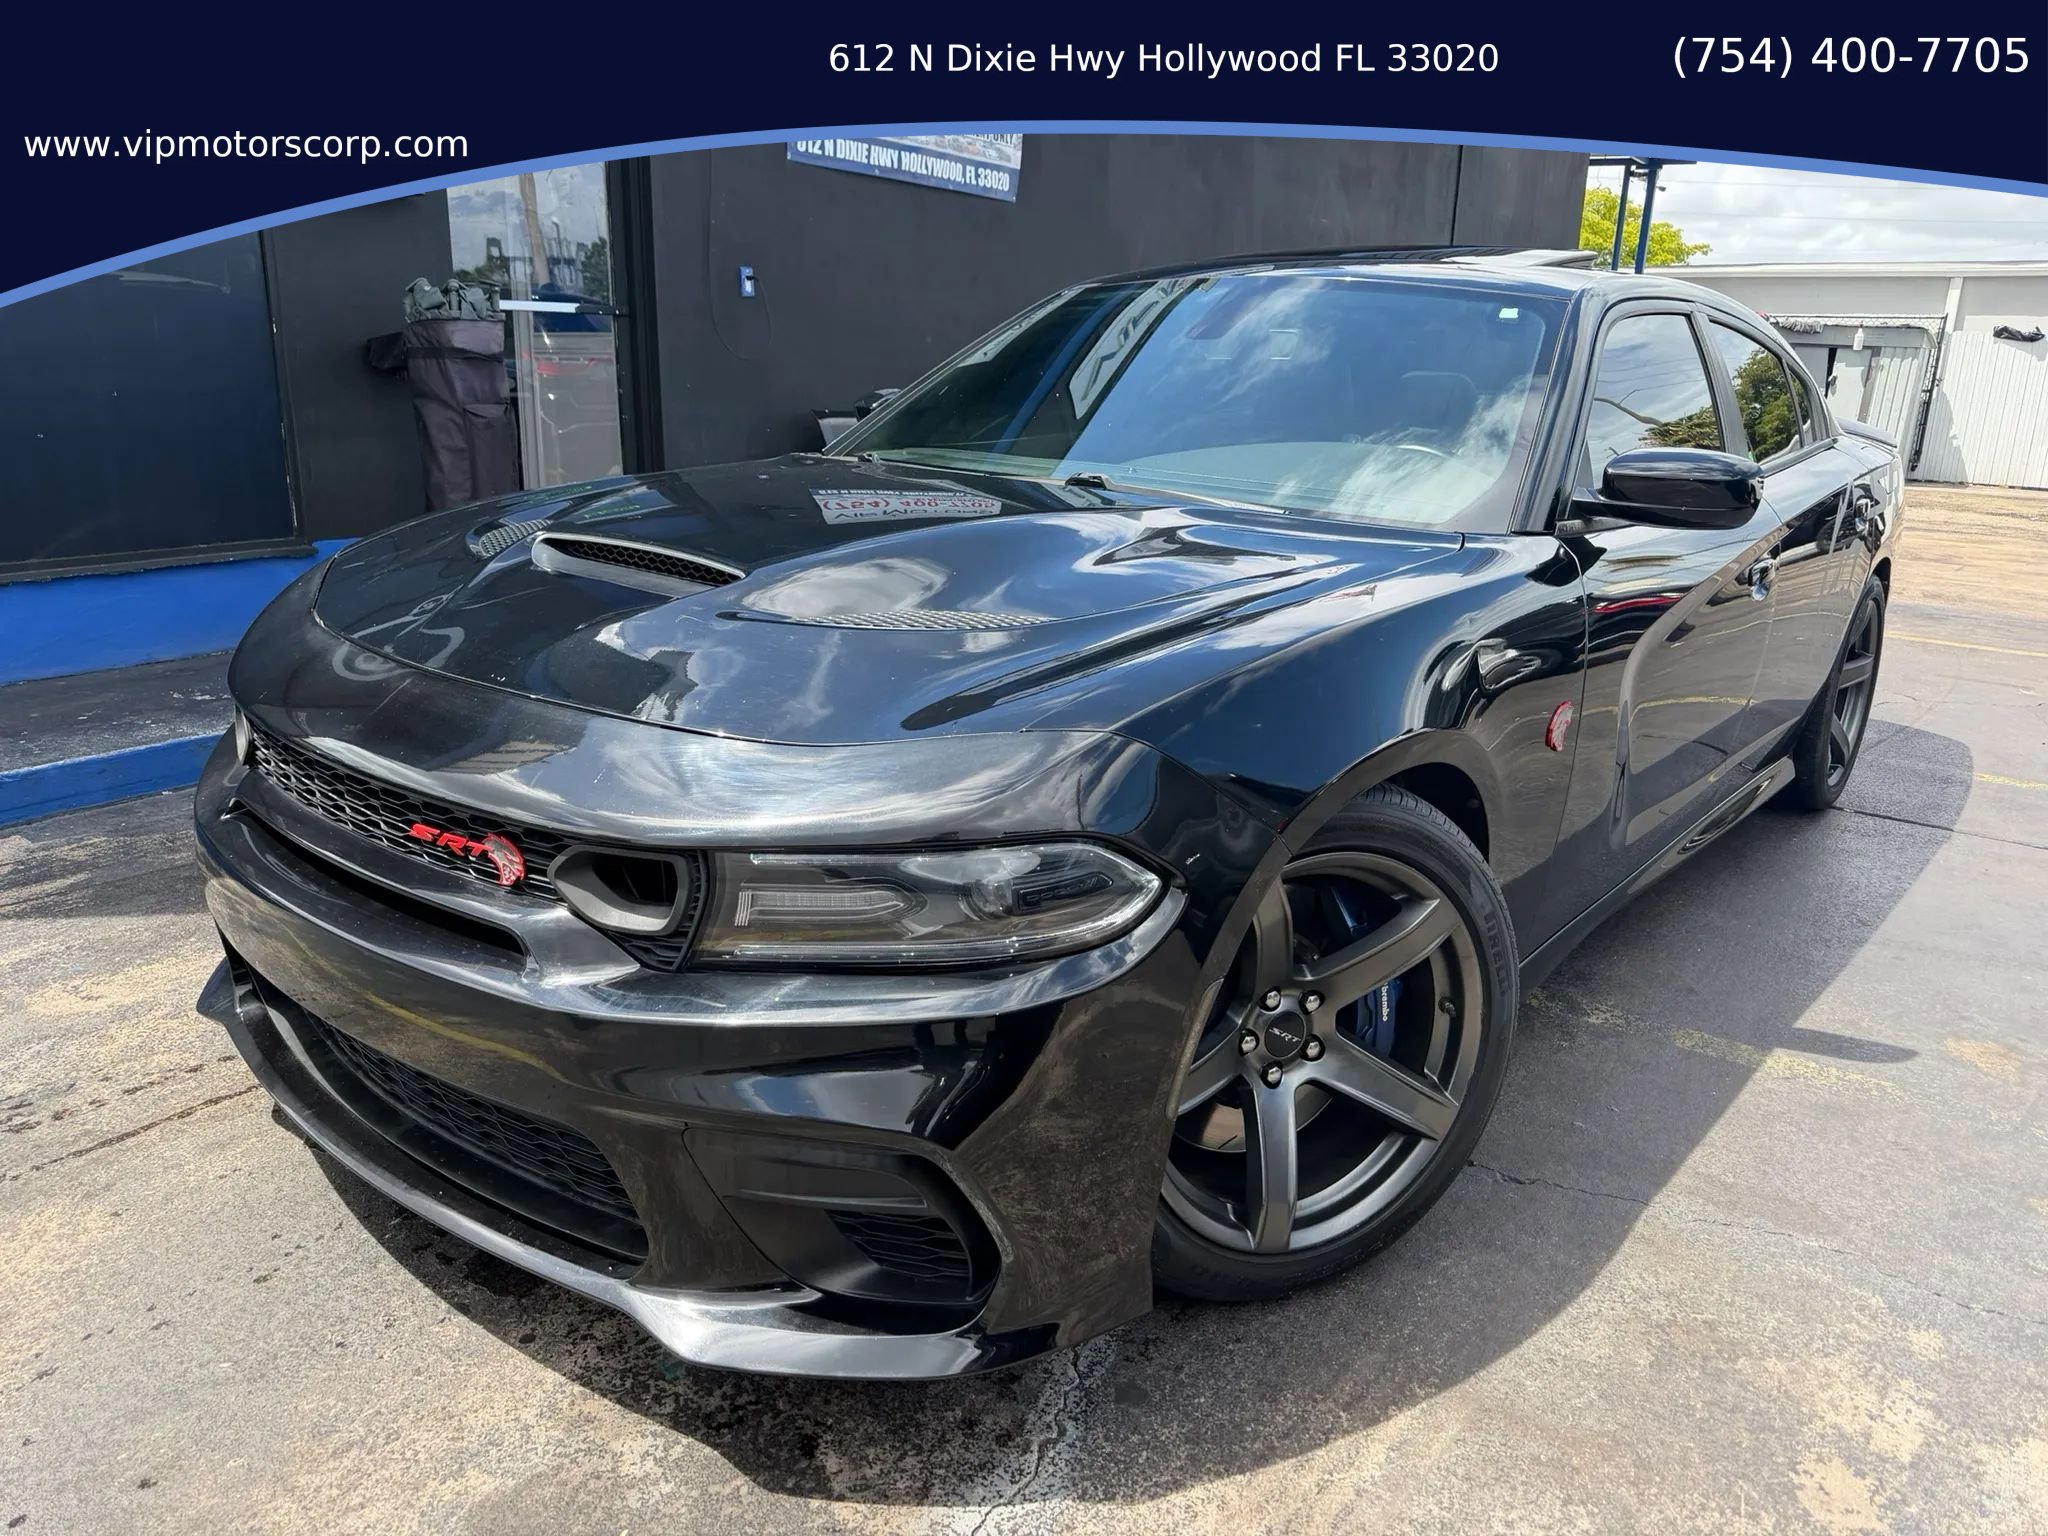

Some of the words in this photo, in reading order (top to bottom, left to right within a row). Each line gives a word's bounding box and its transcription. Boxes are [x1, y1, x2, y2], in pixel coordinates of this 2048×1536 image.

[824, 139, 834, 157] N
[836, 139, 868, 164] DIXIE
[870, 145, 899, 169] HWY
[901, 151, 964, 184] HOLLYWOOD,
[965, 165, 977, 184] FL
[978, 167, 1010, 192] 33020
[408, 823, 494, 857] SRT
[1381, 985, 1391, 1022] brembo
[1268, 1026, 1302, 1043] SRT
